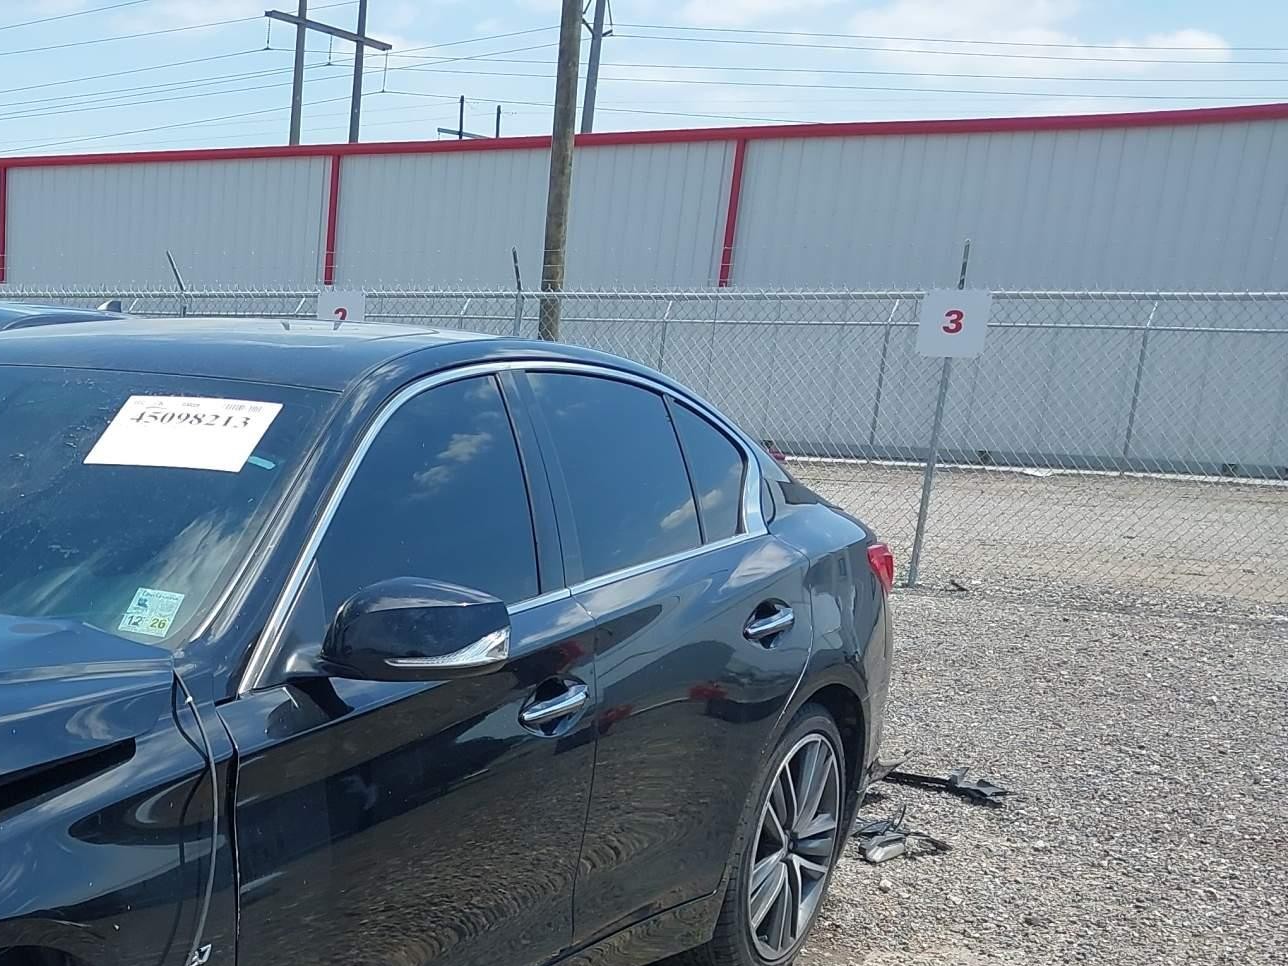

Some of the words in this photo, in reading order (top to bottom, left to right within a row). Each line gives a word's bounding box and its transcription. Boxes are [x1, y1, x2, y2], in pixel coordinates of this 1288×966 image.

[941, 309, 964, 334] 3
[130, 411, 251, 429] 45098213
[127, 615, 143, 627] 12
[150, 618, 167, 630] 26
